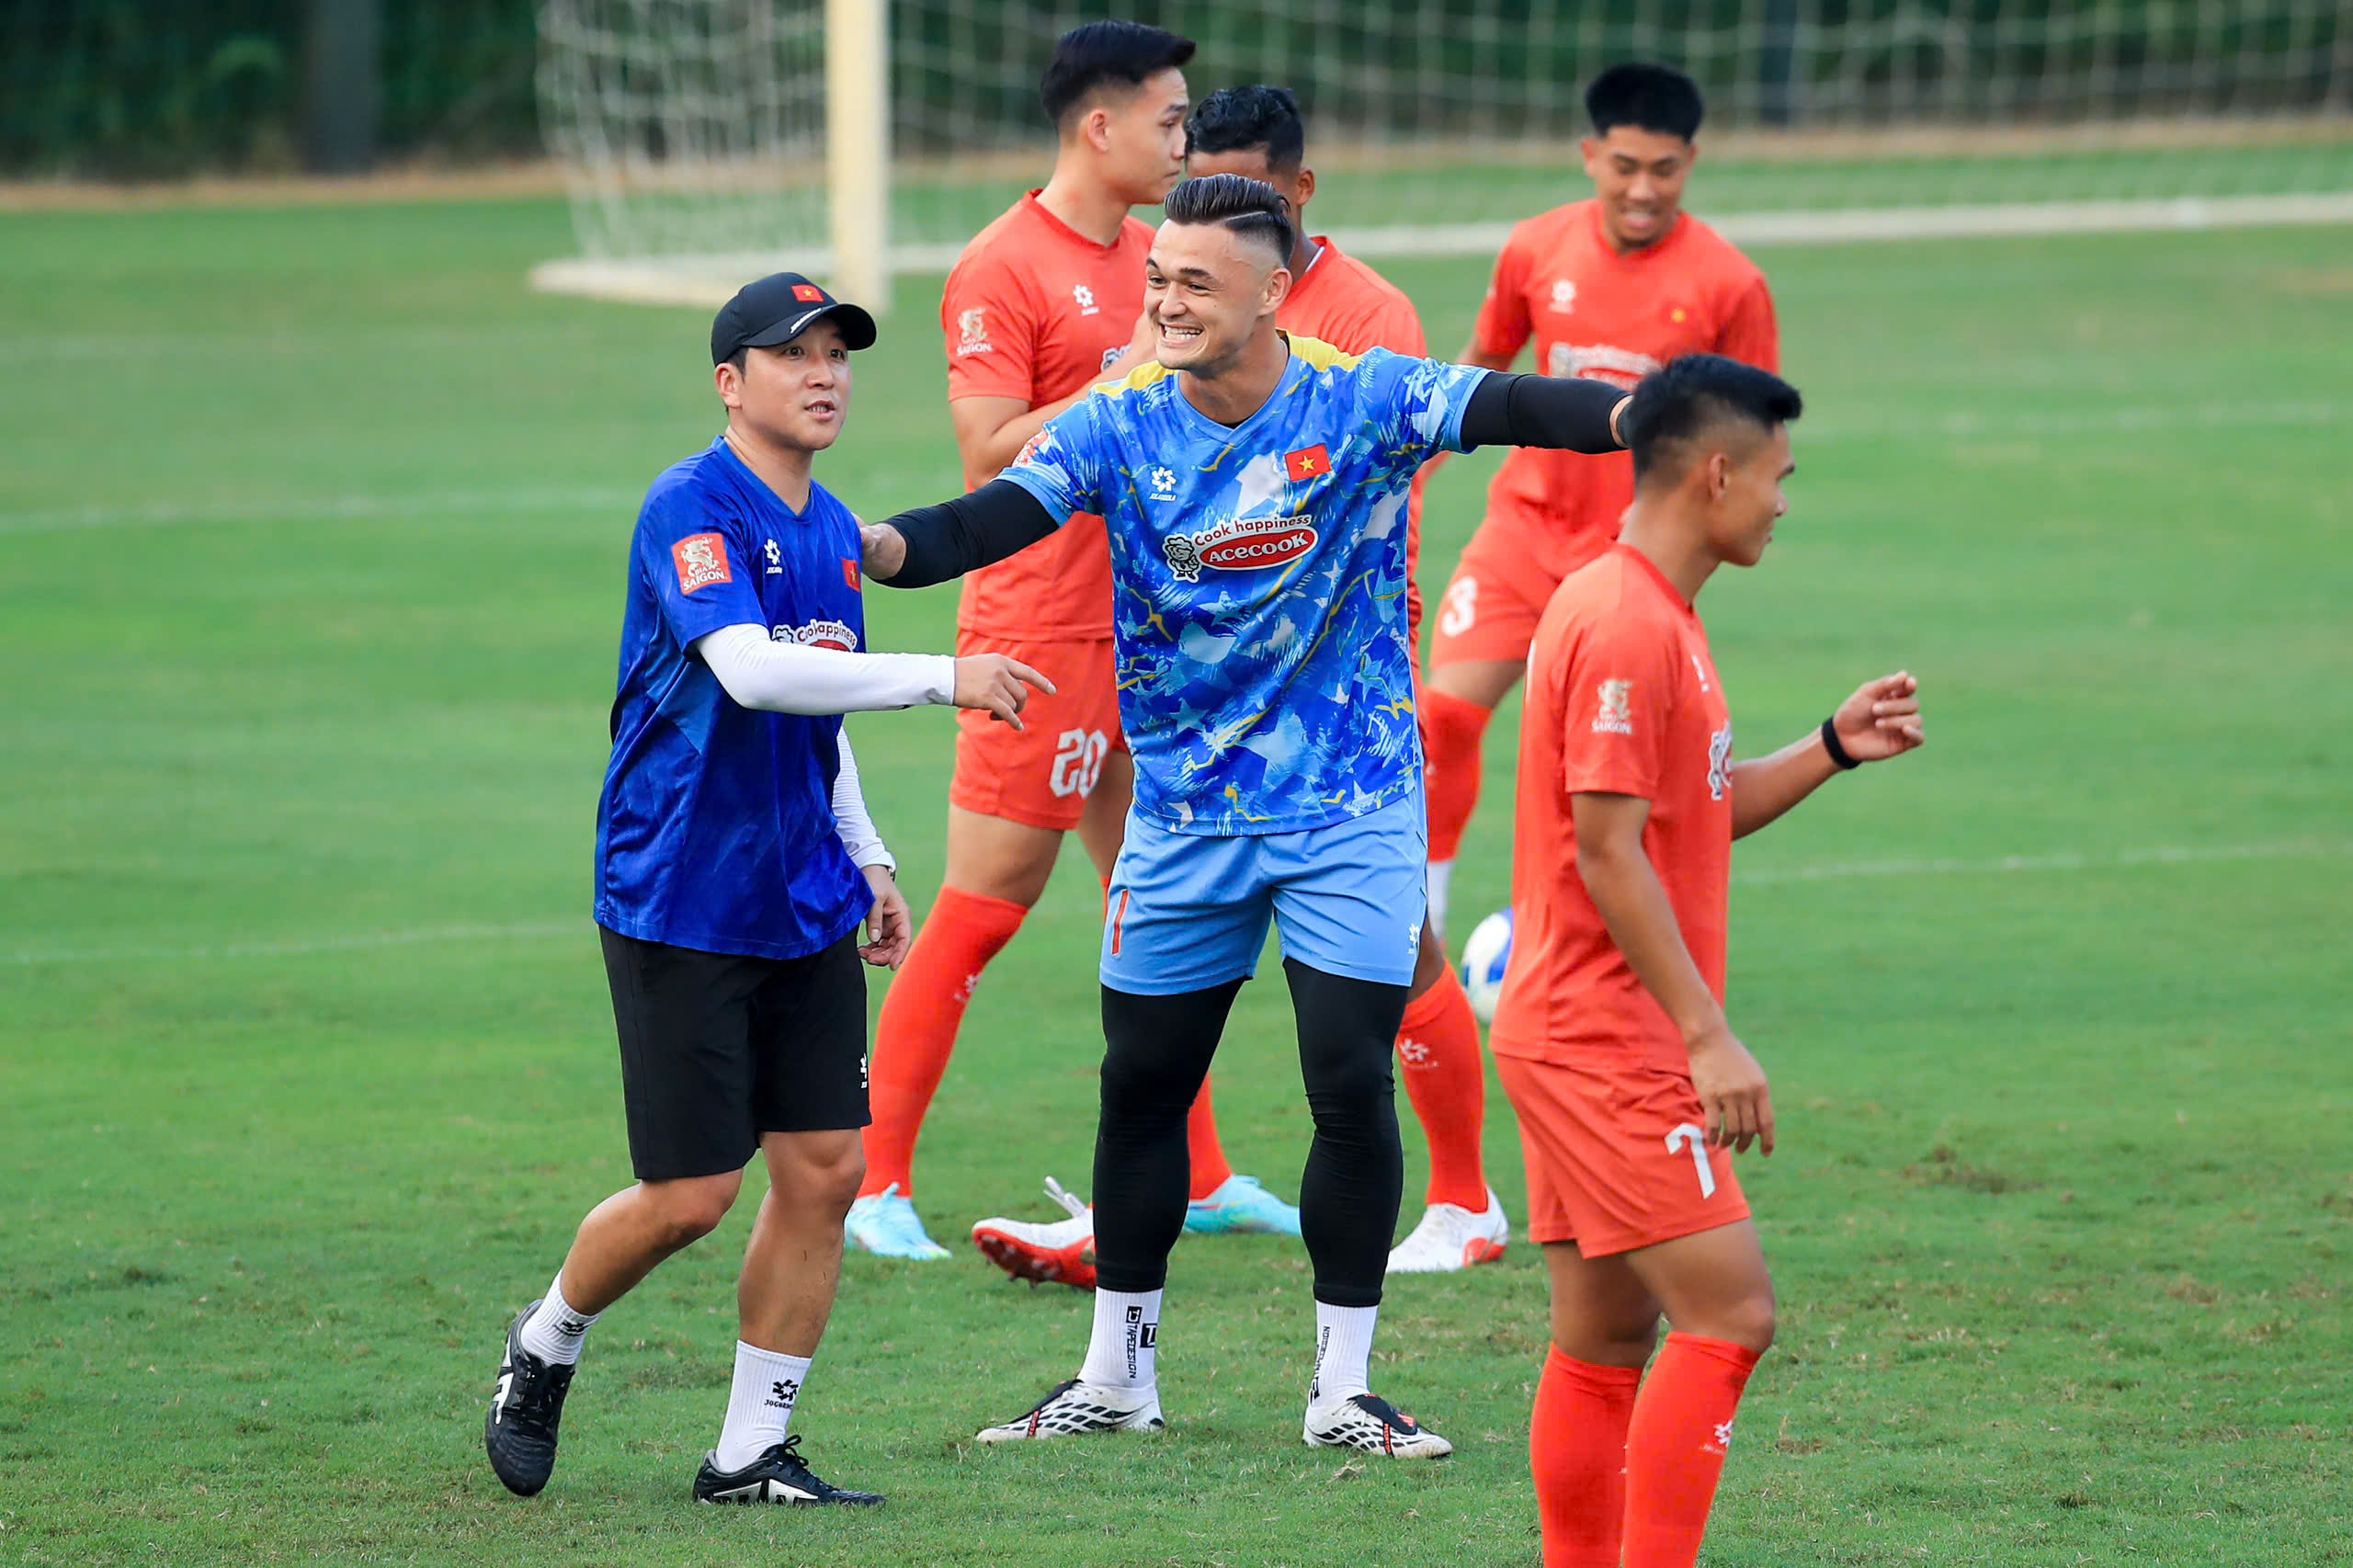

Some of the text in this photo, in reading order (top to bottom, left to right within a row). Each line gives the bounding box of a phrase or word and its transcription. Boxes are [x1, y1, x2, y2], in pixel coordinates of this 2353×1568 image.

[1195, 517, 1310, 547] Cook happiness
[683, 571, 726, 591] SAIGON
[1443, 576, 1477, 636] 3
[1050, 728, 1108, 800] 20
[1665, 1122, 1716, 1199] 7
